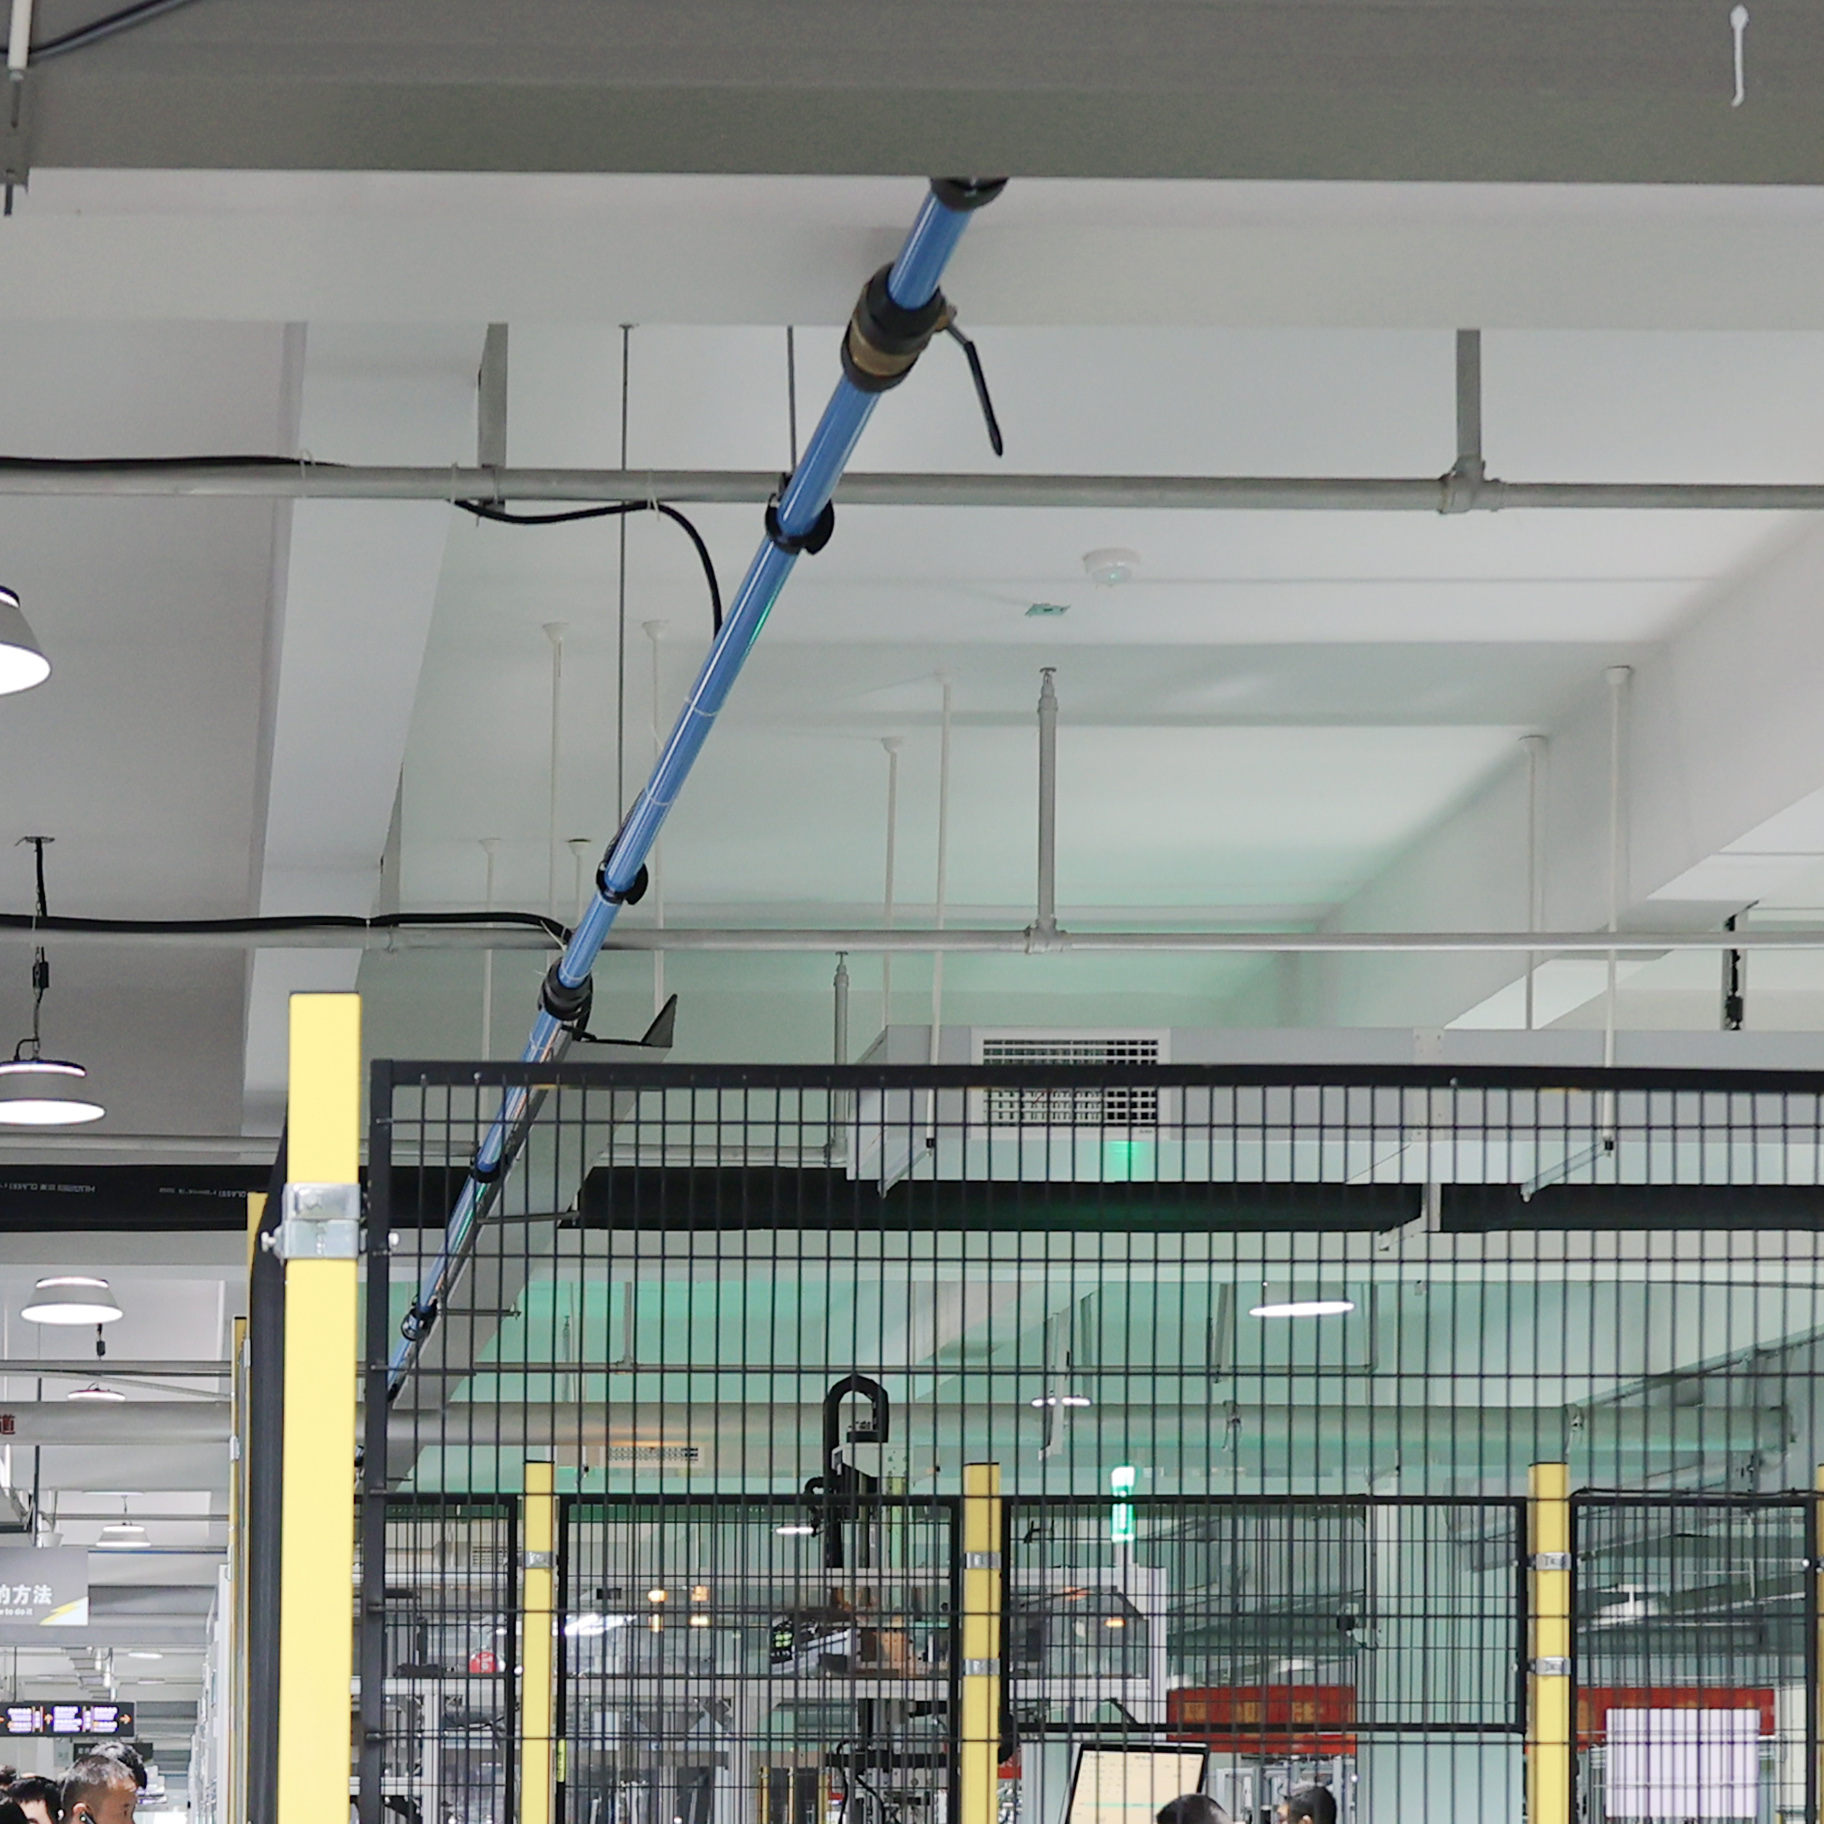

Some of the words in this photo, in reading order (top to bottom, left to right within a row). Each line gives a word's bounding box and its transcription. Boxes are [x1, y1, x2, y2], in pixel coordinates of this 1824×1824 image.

[5, 1607, 14, 1616] to
[14, 1607, 26, 1616] do
[26, 1607, 33, 1616] it
